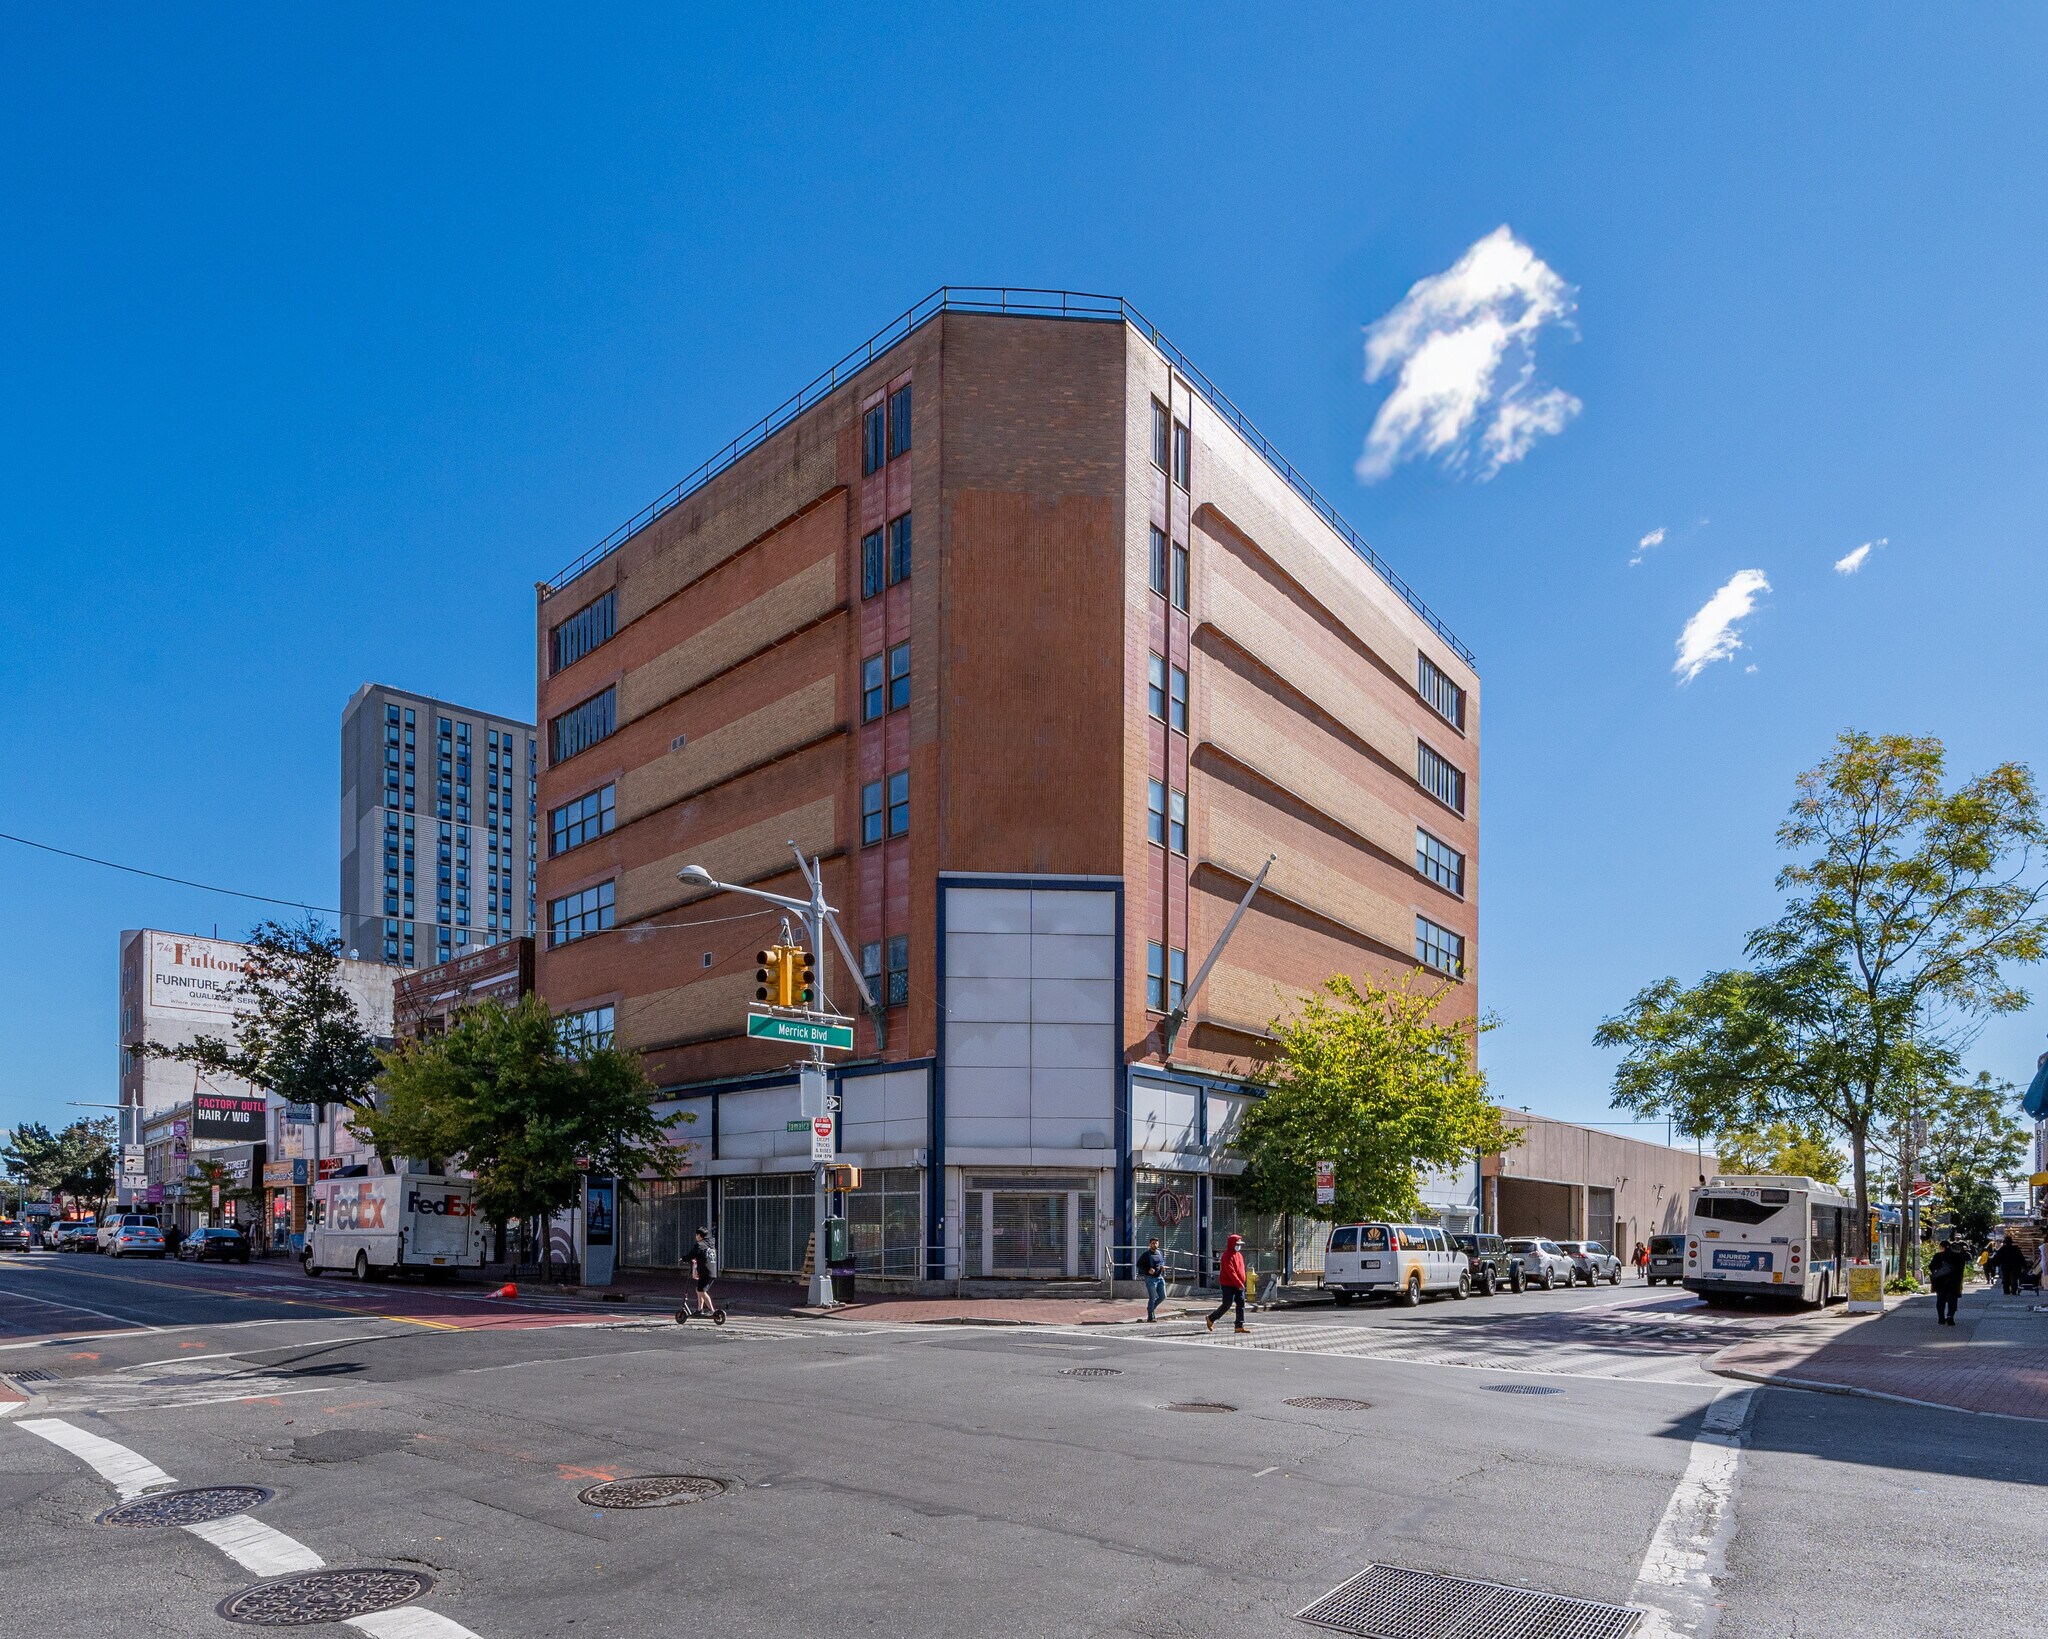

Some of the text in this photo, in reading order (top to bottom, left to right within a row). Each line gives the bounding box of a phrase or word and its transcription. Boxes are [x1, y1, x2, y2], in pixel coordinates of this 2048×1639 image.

[157, 942, 172, 953] The
[172, 943, 239, 972] Fulton
[156, 973, 219, 990] FURNITURE
[189, 991, 224, 1001] QUALI
[778, 1023, 828, 1041] Merrick Blvd
[198, 1098, 237, 1110] FACTORY
[198, 1109, 221, 1121] HAIR
[232, 1111, 250, 1122] WIG
[788, 1122, 810, 1131] Jamaica
[328, 1183, 386, 1230] FedEx
[408, 1191, 477, 1217] FedEx
[1407, 1234, 1424, 1246] Mpower
